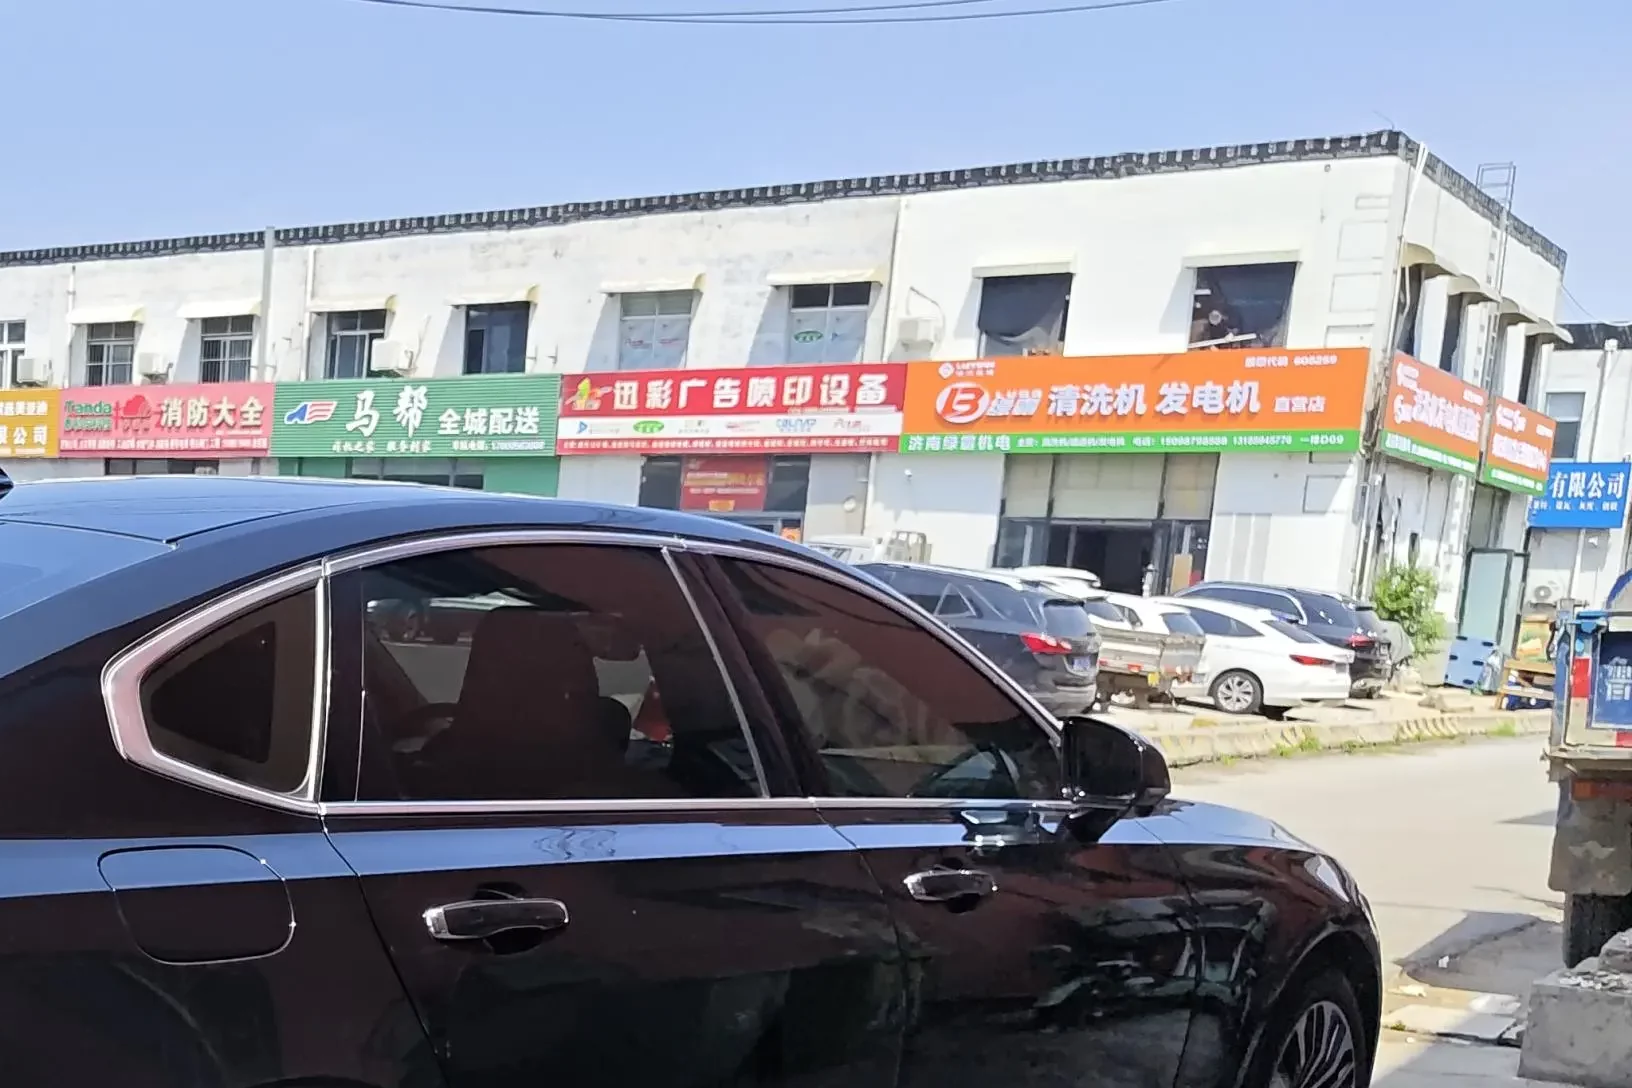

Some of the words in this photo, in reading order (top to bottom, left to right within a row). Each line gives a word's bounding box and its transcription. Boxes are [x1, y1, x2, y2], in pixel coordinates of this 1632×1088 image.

[611, 373, 889, 411] 迅彩广告喷印设备
[1048, 383, 1148, 417] 清洗机
[1155, 379, 1262, 415] 发电机
[1274, 396, 1327, 413] 直营店
[159, 396, 265, 429] 消防大全
[345, 385, 428, 438] 马帮
[438, 407, 540, 436] 全城配送
[1549, 470, 1625, 500] 有限公司
